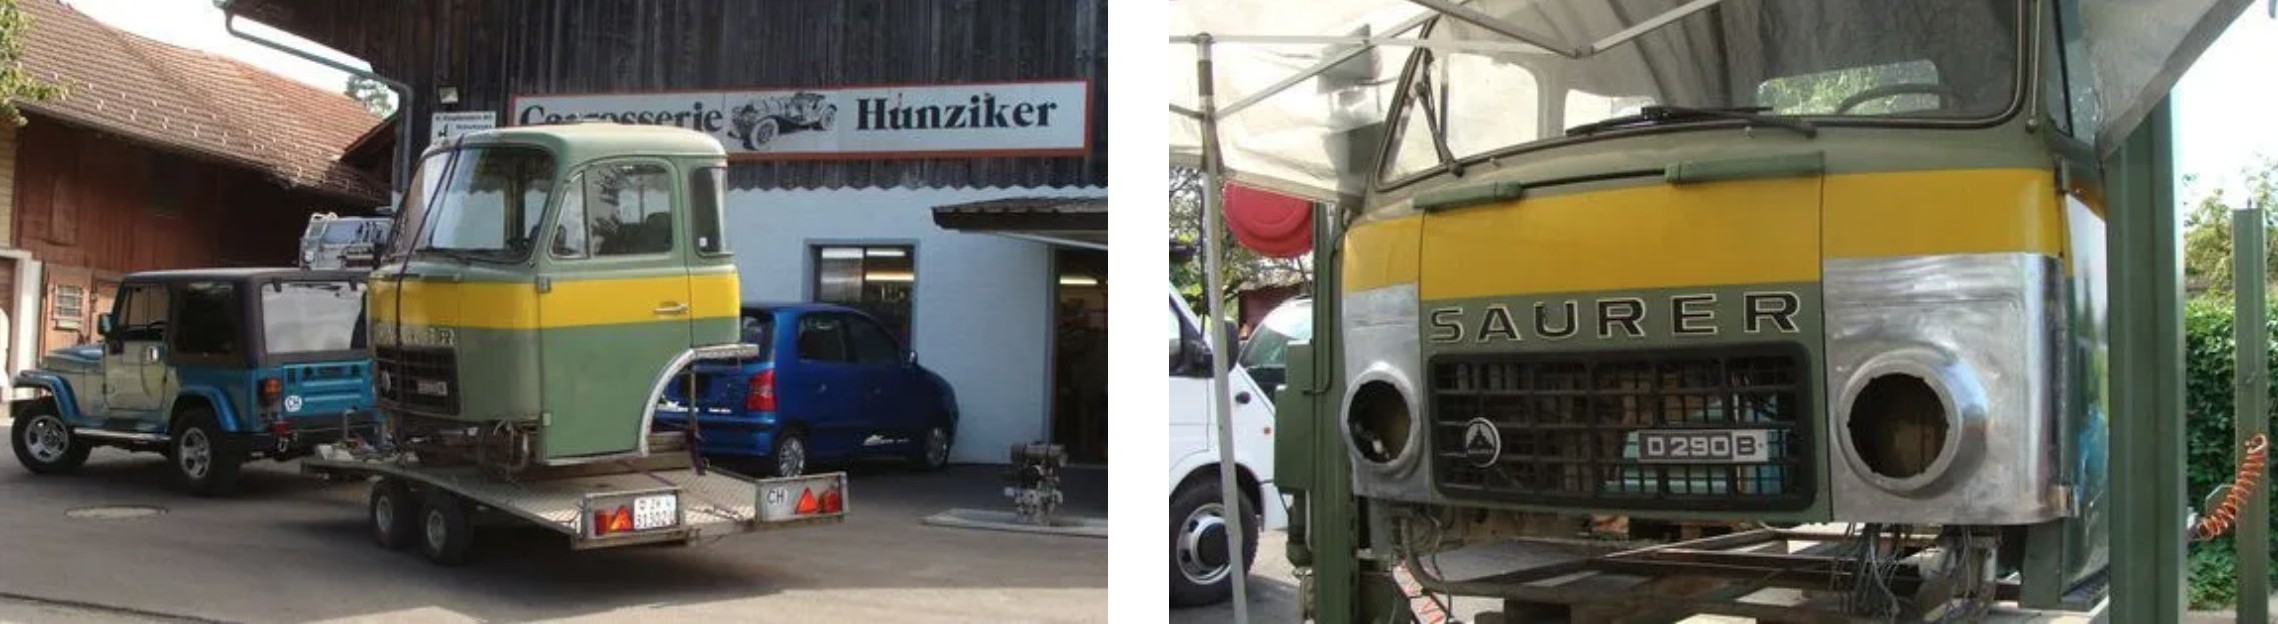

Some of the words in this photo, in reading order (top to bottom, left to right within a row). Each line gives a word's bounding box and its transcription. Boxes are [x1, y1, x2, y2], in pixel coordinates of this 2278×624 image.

[856, 93, 1058, 131] Hunziker
[1428, 291, 1801, 344] SAURER
[767, 488, 784, 504] CH
